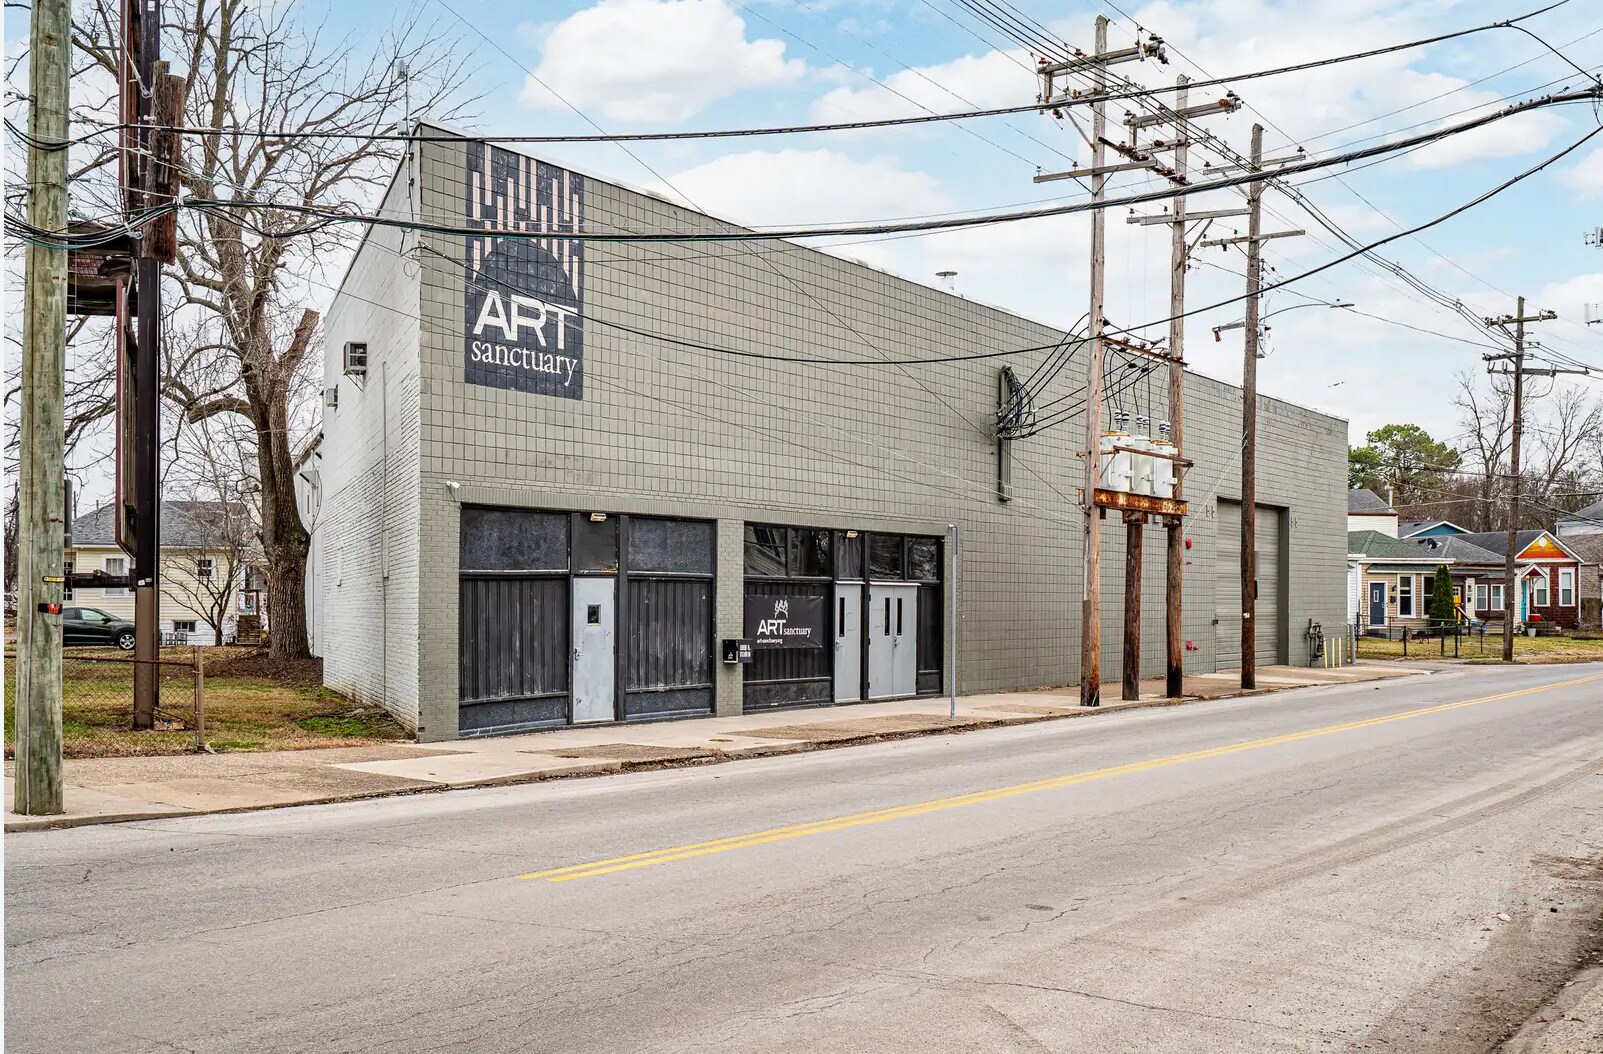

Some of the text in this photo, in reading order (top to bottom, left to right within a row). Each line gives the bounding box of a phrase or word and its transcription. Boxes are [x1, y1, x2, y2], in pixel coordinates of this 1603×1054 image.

[472, 290, 578, 350] ART
[471, 340, 578, 387] sanctuary
[757, 619, 812, 638] ART sanctuary
